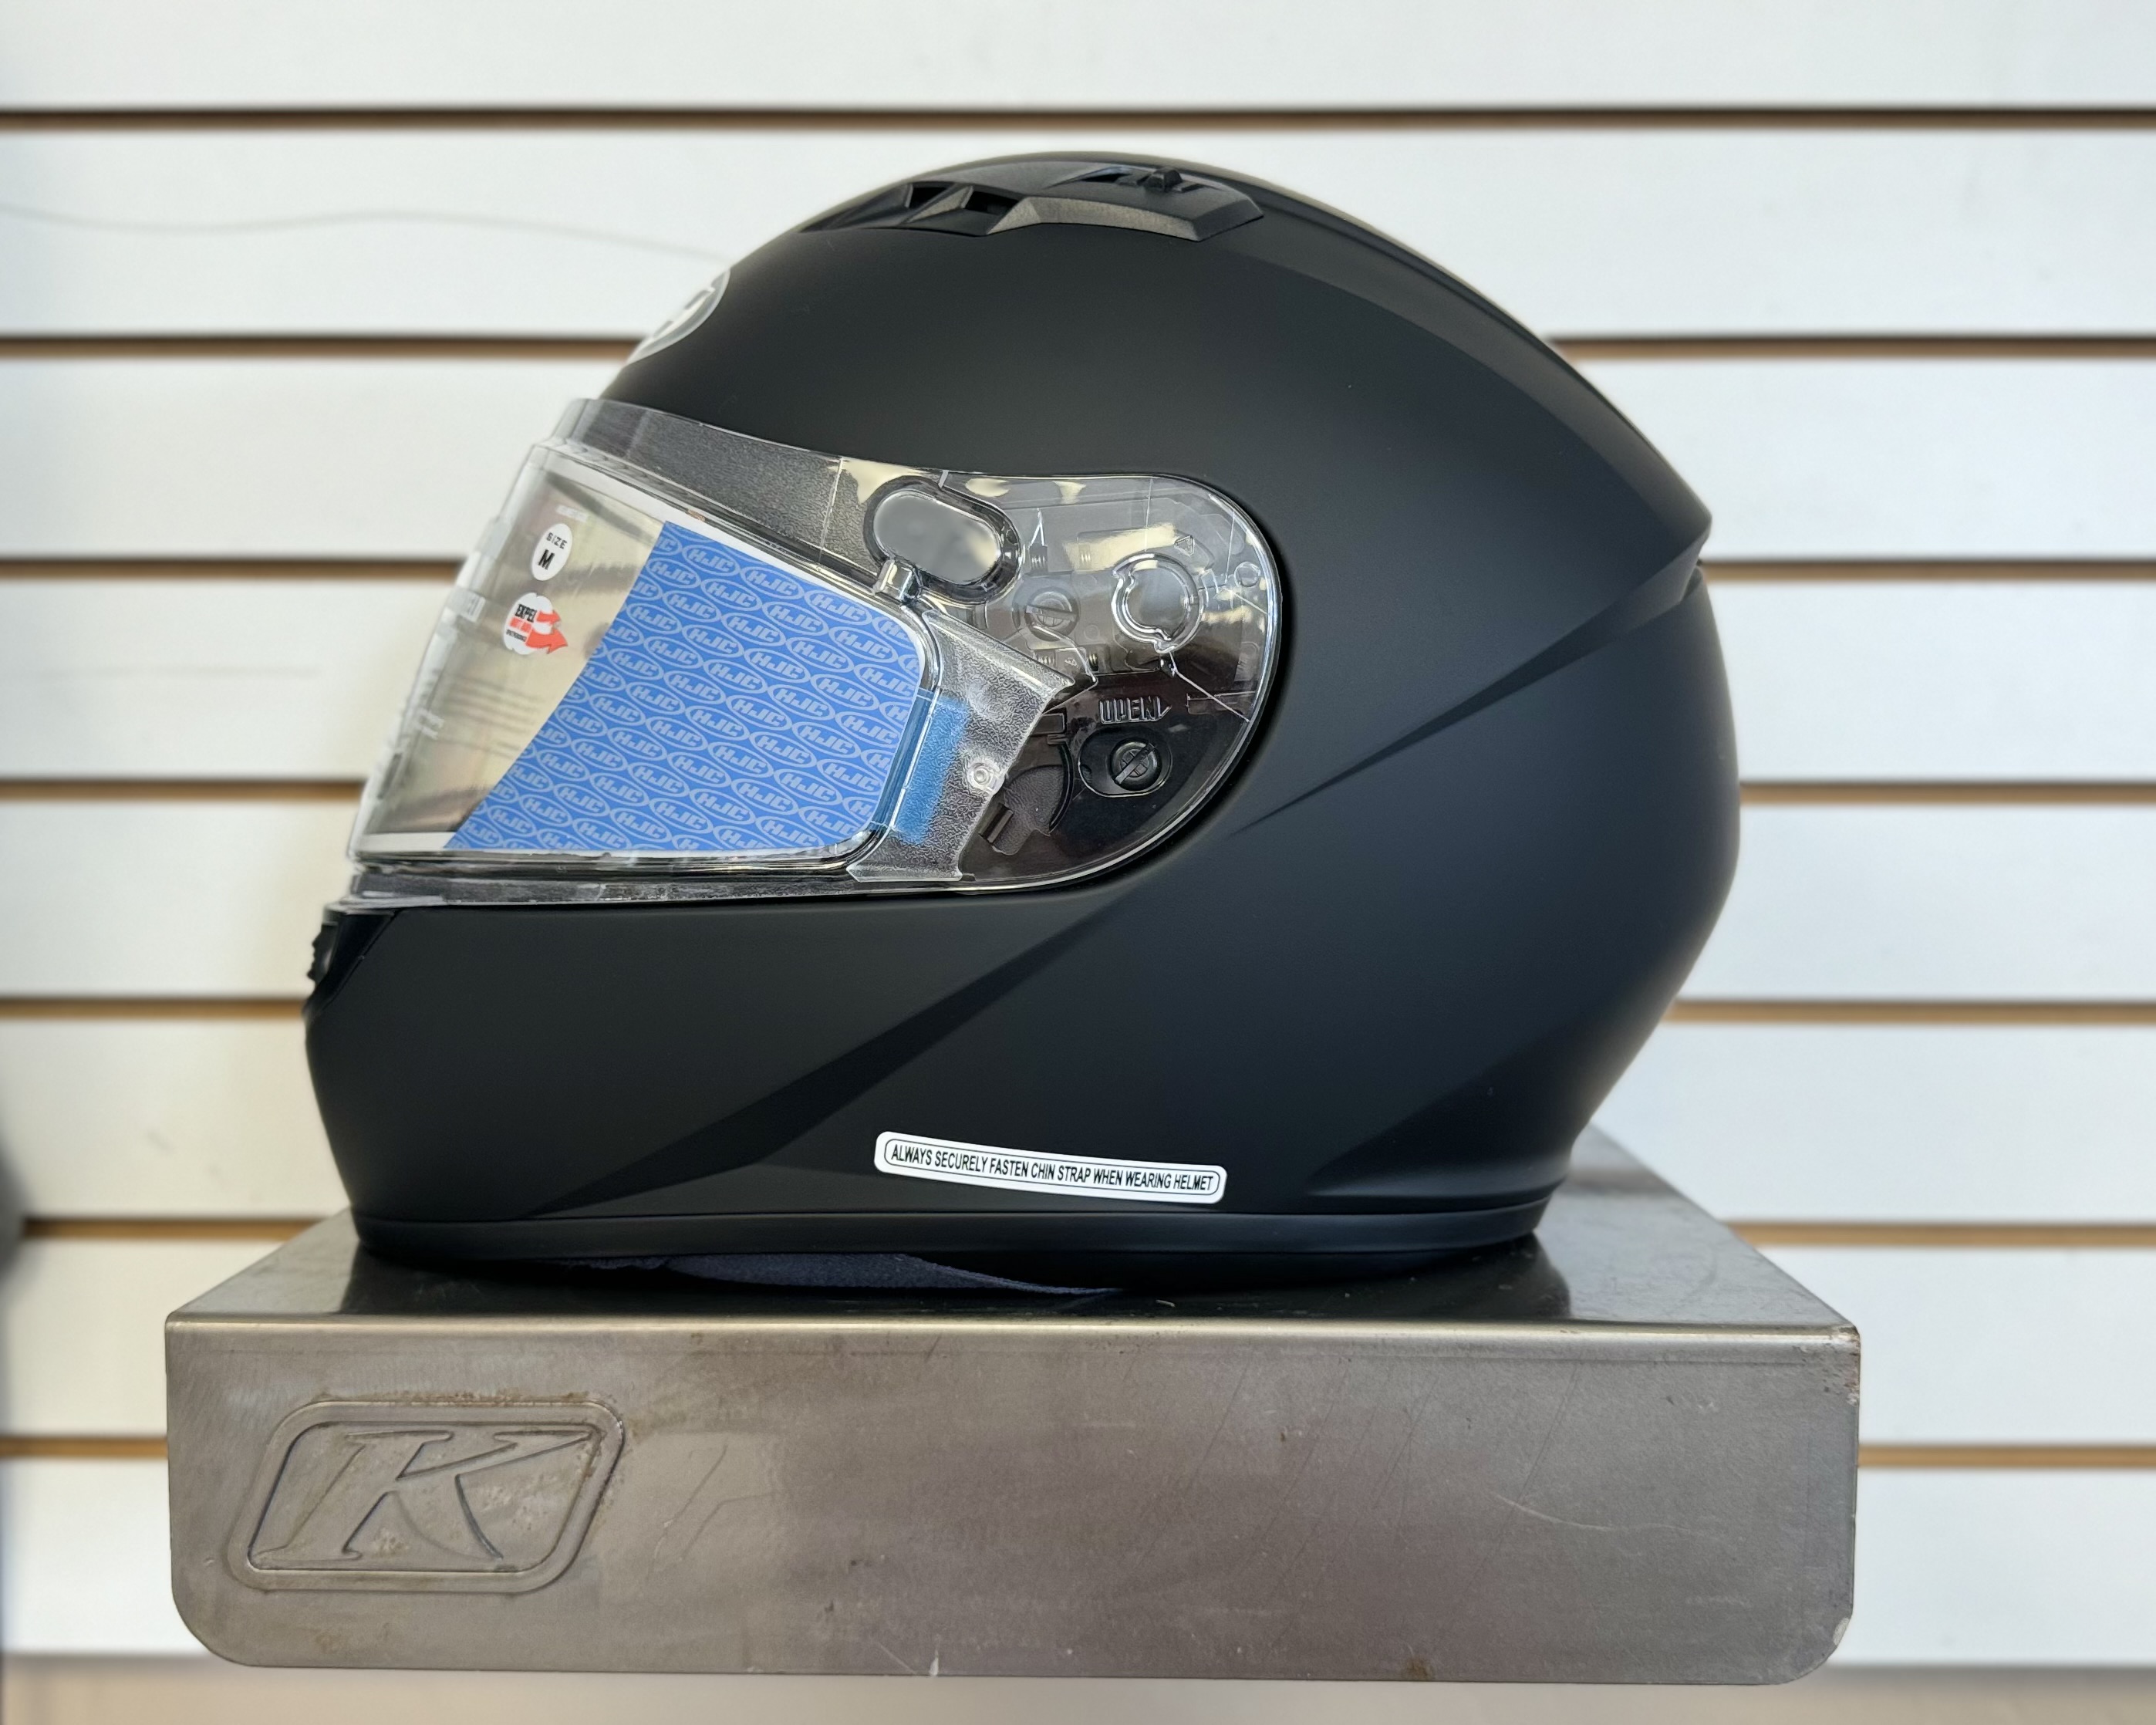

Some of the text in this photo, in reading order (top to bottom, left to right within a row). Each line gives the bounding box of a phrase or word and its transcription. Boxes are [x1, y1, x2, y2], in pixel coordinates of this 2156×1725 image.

[546, 532, 568, 550] SIZE
[656, 538, 676, 552] JC
[538, 549, 555, 570] M
[687, 549, 732, 572] HJC
[651, 562, 694, 583] HJC
[747, 571, 796, 595] HJC
[633, 581, 656, 596] JC
[707, 582, 755, 606] HJC
[633, 607, 676, 630] HJC
[668, 595, 715, 618] HJC
[770, 606, 822, 631] HJC
[811, 593, 865, 620] HJC
[608, 626, 639, 643] JC
[688, 629, 737, 653] HJC
[728, 617, 779, 642] HJC
[650, 641, 697, 663] HJC
[793, 641, 846, 668] HJC
[836, 631, 890, 658] HJC
[614, 653, 658, 675] HJC
[710, 663, 761, 688] HJC
[751, 653, 803, 678] HJC
[670, 675, 719, 700] HJC
[818, 678, 872, 706] HJC
[861, 668, 915, 696] HJC
[596, 697, 639, 721] HJC
[633, 687, 679, 710] HJC
[775, 689, 828, 716] HJC
[560, 709, 601, 732] HJC
[693, 710, 742, 736] HJC
[733, 700, 785, 725] HJC
[540, 727, 562, 744] JC
[614, 731, 661, 754] HJC
[653, 721, 700, 746] HJC
[800, 726, 853, 753] HJC
[844, 716, 897, 744] HJC
[577, 743, 620, 766] HJC
[716, 747, 766, 773] HJC
[757, 737, 809, 763] HJC
[542, 754, 583, 776] HJC
[675, 757, 724, 782] HJC
[824, 763, 878, 791] HJC
[493, 784, 514, 798] JC
[596, 777, 642, 802] HJC
[636, 767, 683, 792] HJC
[781, 774, 835, 801] HJC
[559, 788, 604, 812] HJC
[697, 793, 748, 819] HJC
[739, 783, 791, 811] HJC
[493, 809, 531, 833] HJC
[525, 799, 566, 822] HJC
[656, 802, 706, 829] HJC
[579, 822, 627, 848] HJC
[617, 812, 665, 838] HJC
[764, 821, 817, 846] HJC
[891, 1144, 1214, 1191] ALWAYS SECURELY FASTEN CHIN STRAP WHEN WEARING HELMET
